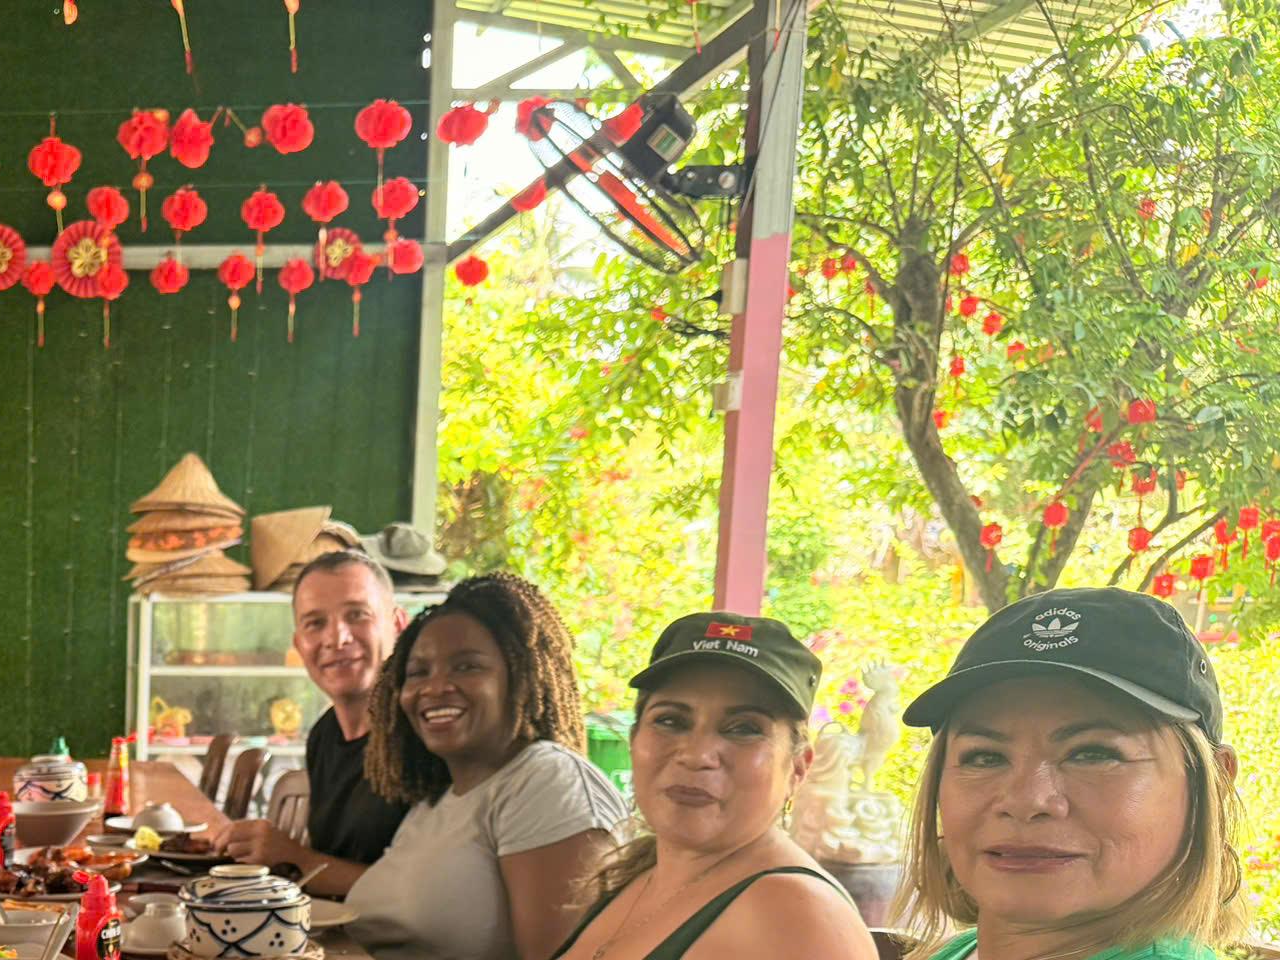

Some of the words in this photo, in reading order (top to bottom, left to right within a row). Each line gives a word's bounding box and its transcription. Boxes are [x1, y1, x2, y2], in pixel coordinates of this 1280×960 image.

[1035, 607, 1081, 621] adidas
[692, 640, 721, 650] Viet
[726, 640, 759, 657] Nam
